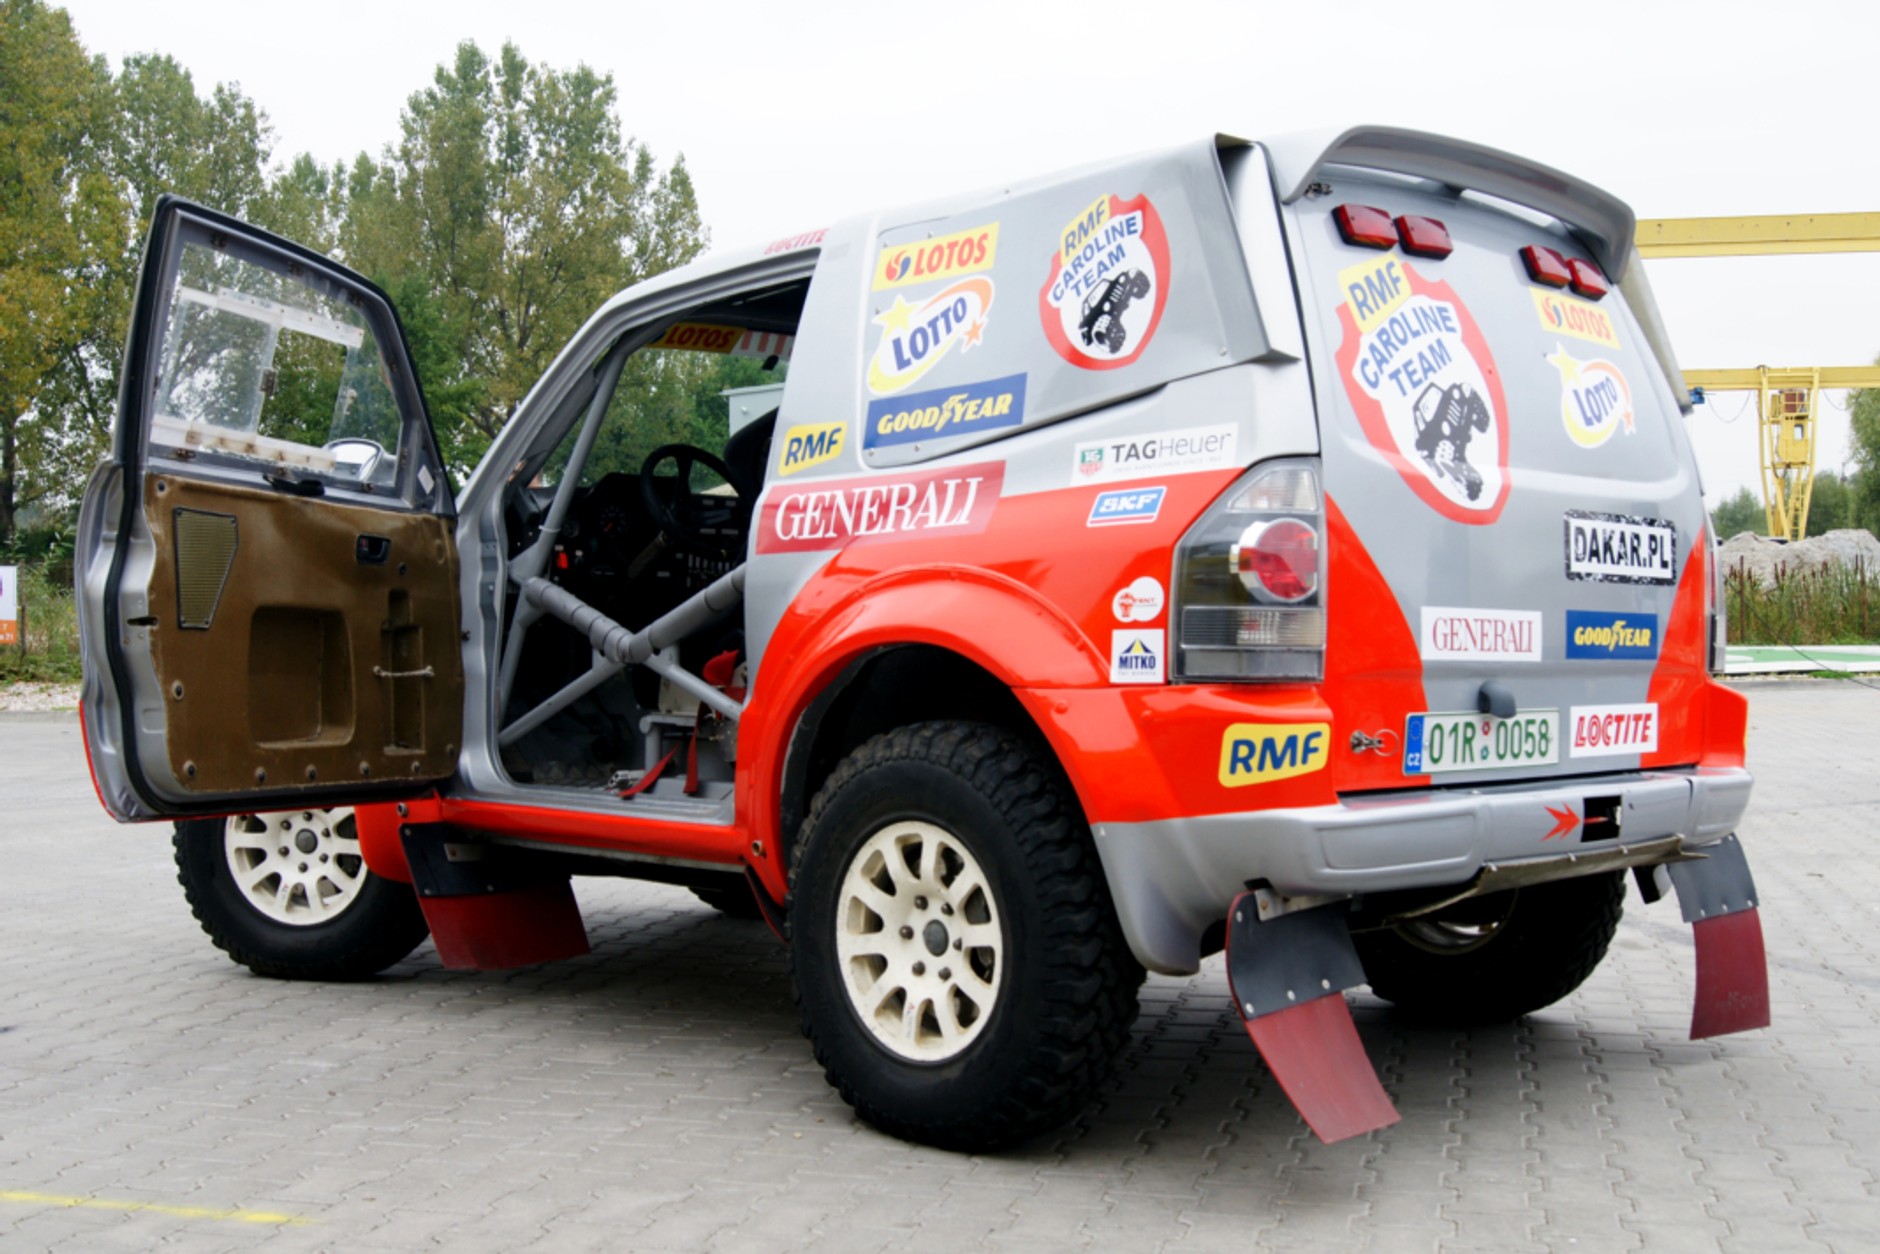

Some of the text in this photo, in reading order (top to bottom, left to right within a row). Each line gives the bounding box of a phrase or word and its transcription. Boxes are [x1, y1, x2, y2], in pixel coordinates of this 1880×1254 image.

[1065, 199, 1105, 257] RMF
[913, 232, 989, 277] LOTOS
[1052, 216, 1138, 302] CAROLINE
[1070, 243, 1126, 297] TEAM
[1348, 260, 1401, 321] RMF
[664, 325, 735, 349] LOTOS
[892, 296, 968, 371] LOTTO
[1559, 301, 1611, 341] LOTOS
[1360, 304, 1457, 389] CAROLINE
[1387, 337, 1453, 397] TEAM
[876, 393, 1013, 434] GOODYEAR
[1572, 376, 1618, 427] LOTTO
[784, 427, 842, 467] RMF
[774, 477, 984, 541] GENERALI
[1098, 493, 1158, 513] SKF
[1573, 525, 1670, 570] DAKAR.PL
[1432, 616, 1533, 653] GENERALI
[1574, 620, 1651, 651] GOODYEAR
[1118, 655, 1157, 670] MITKO
[1229, 731, 1323, 775] RMF
[1428, 719, 1550, 765] 01R 0058
[1574, 713, 1653, 748] LOCTITE
[1407, 753, 1421, 767] CZ
